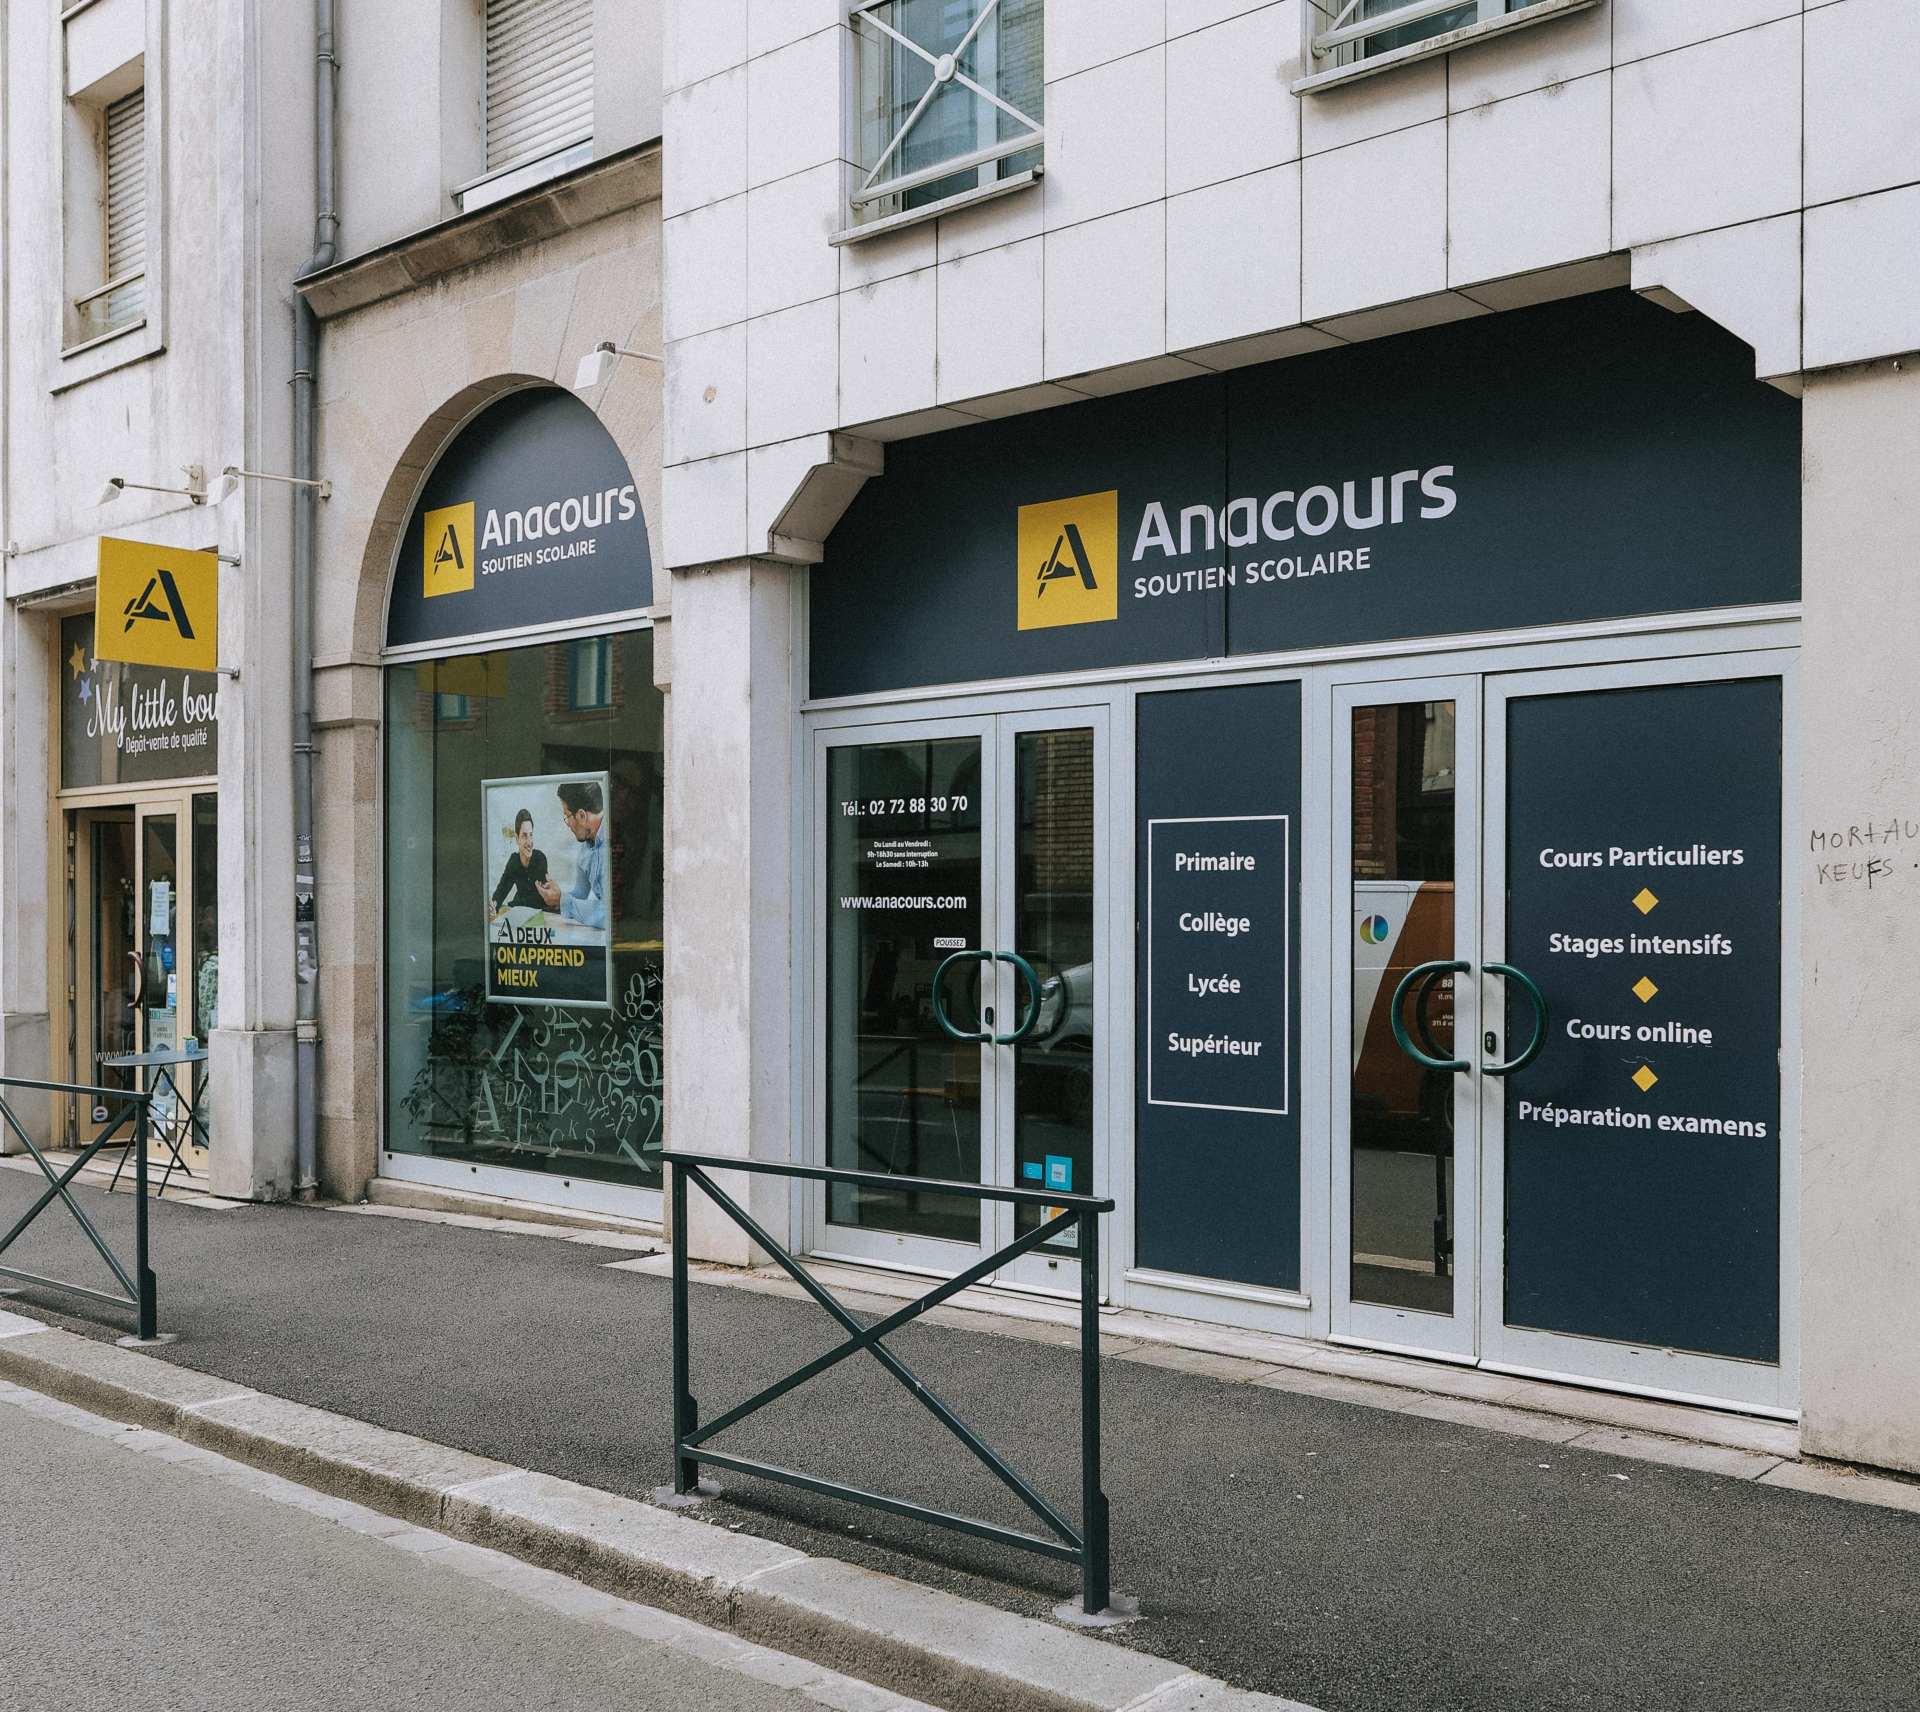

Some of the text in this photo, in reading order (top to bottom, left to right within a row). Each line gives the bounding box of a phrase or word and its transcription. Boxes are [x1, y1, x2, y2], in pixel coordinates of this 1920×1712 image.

[481, 484, 636, 550] Anacours
[1131, 464, 1457, 562] Anacours
[482, 539, 596, 575] SOUTIEN SCOLAIRE
[1133, 547, 1371, 598] SOUTIEN SCOLAIRE
[87, 681, 127, 748] My
[132, 677, 178, 731] little
[125, 726, 208, 758] Dépôt-vente de qualité
[869, 800, 885, 815] 02
[889, 799, 905, 814] 72
[909, 798, 925, 813] 88
[930, 797, 947, 812] 30
[951, 795, 968, 811] 70
[1175, 851, 1256, 872] Primaire
[1539, 845, 1744, 869] Cours Particuliers
[840, 895, 968, 910] www.anacours.com
[516, 927, 553, 945] DEUX
[1179, 912, 1250, 937] Collège
[935, 939, 964, 947] POUSSEZ
[1549, 933, 1733, 958] Stages intensifs
[497, 947, 585, 967] ON APPREND
[498, 968, 539, 987] MIEUX
[1188, 973, 1241, 997] Lycée
[1566, 1018, 1713, 1045] Cours online
[1168, 1032, 1262, 1058] Supérieur
[1519, 1101, 1767, 1138] Préparation examens
